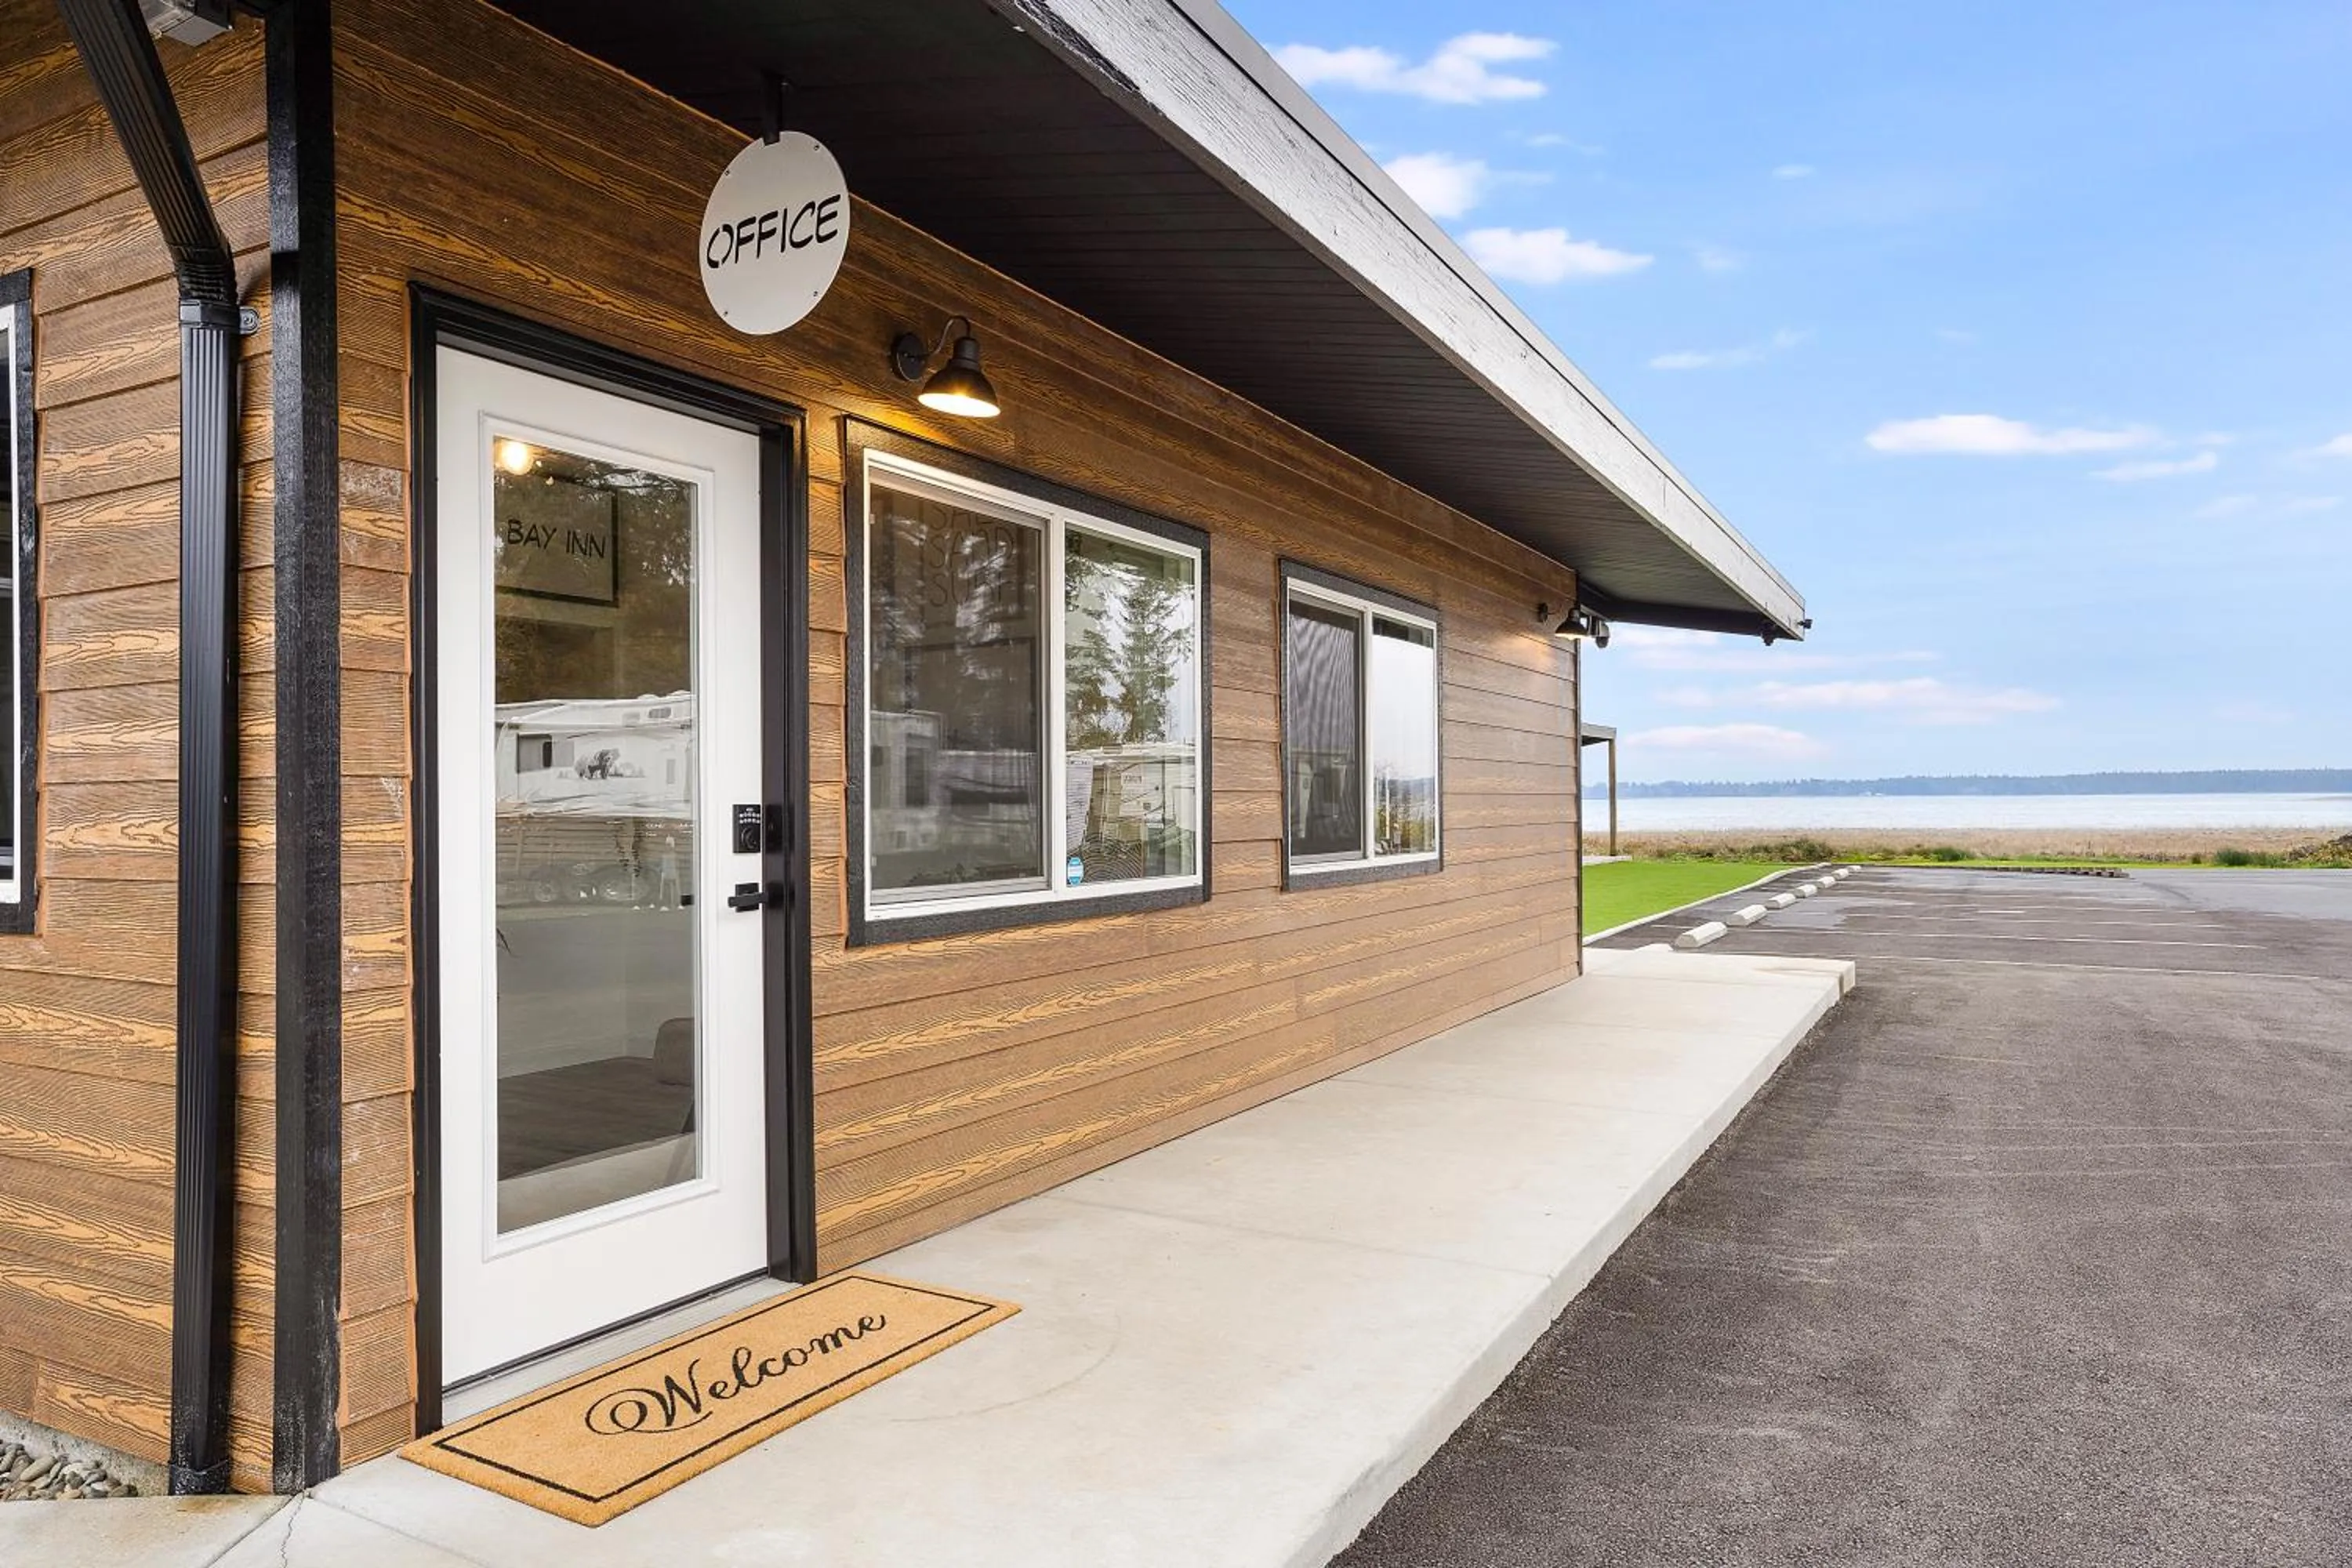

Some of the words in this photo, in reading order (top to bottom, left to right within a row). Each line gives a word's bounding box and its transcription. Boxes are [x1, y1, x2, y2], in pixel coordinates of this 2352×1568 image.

[706, 194, 841, 269] OFFICE
[507, 518, 557, 550] BAY
[565, 530, 605, 559] INN
[584, 1313, 886, 1436] Welcome
